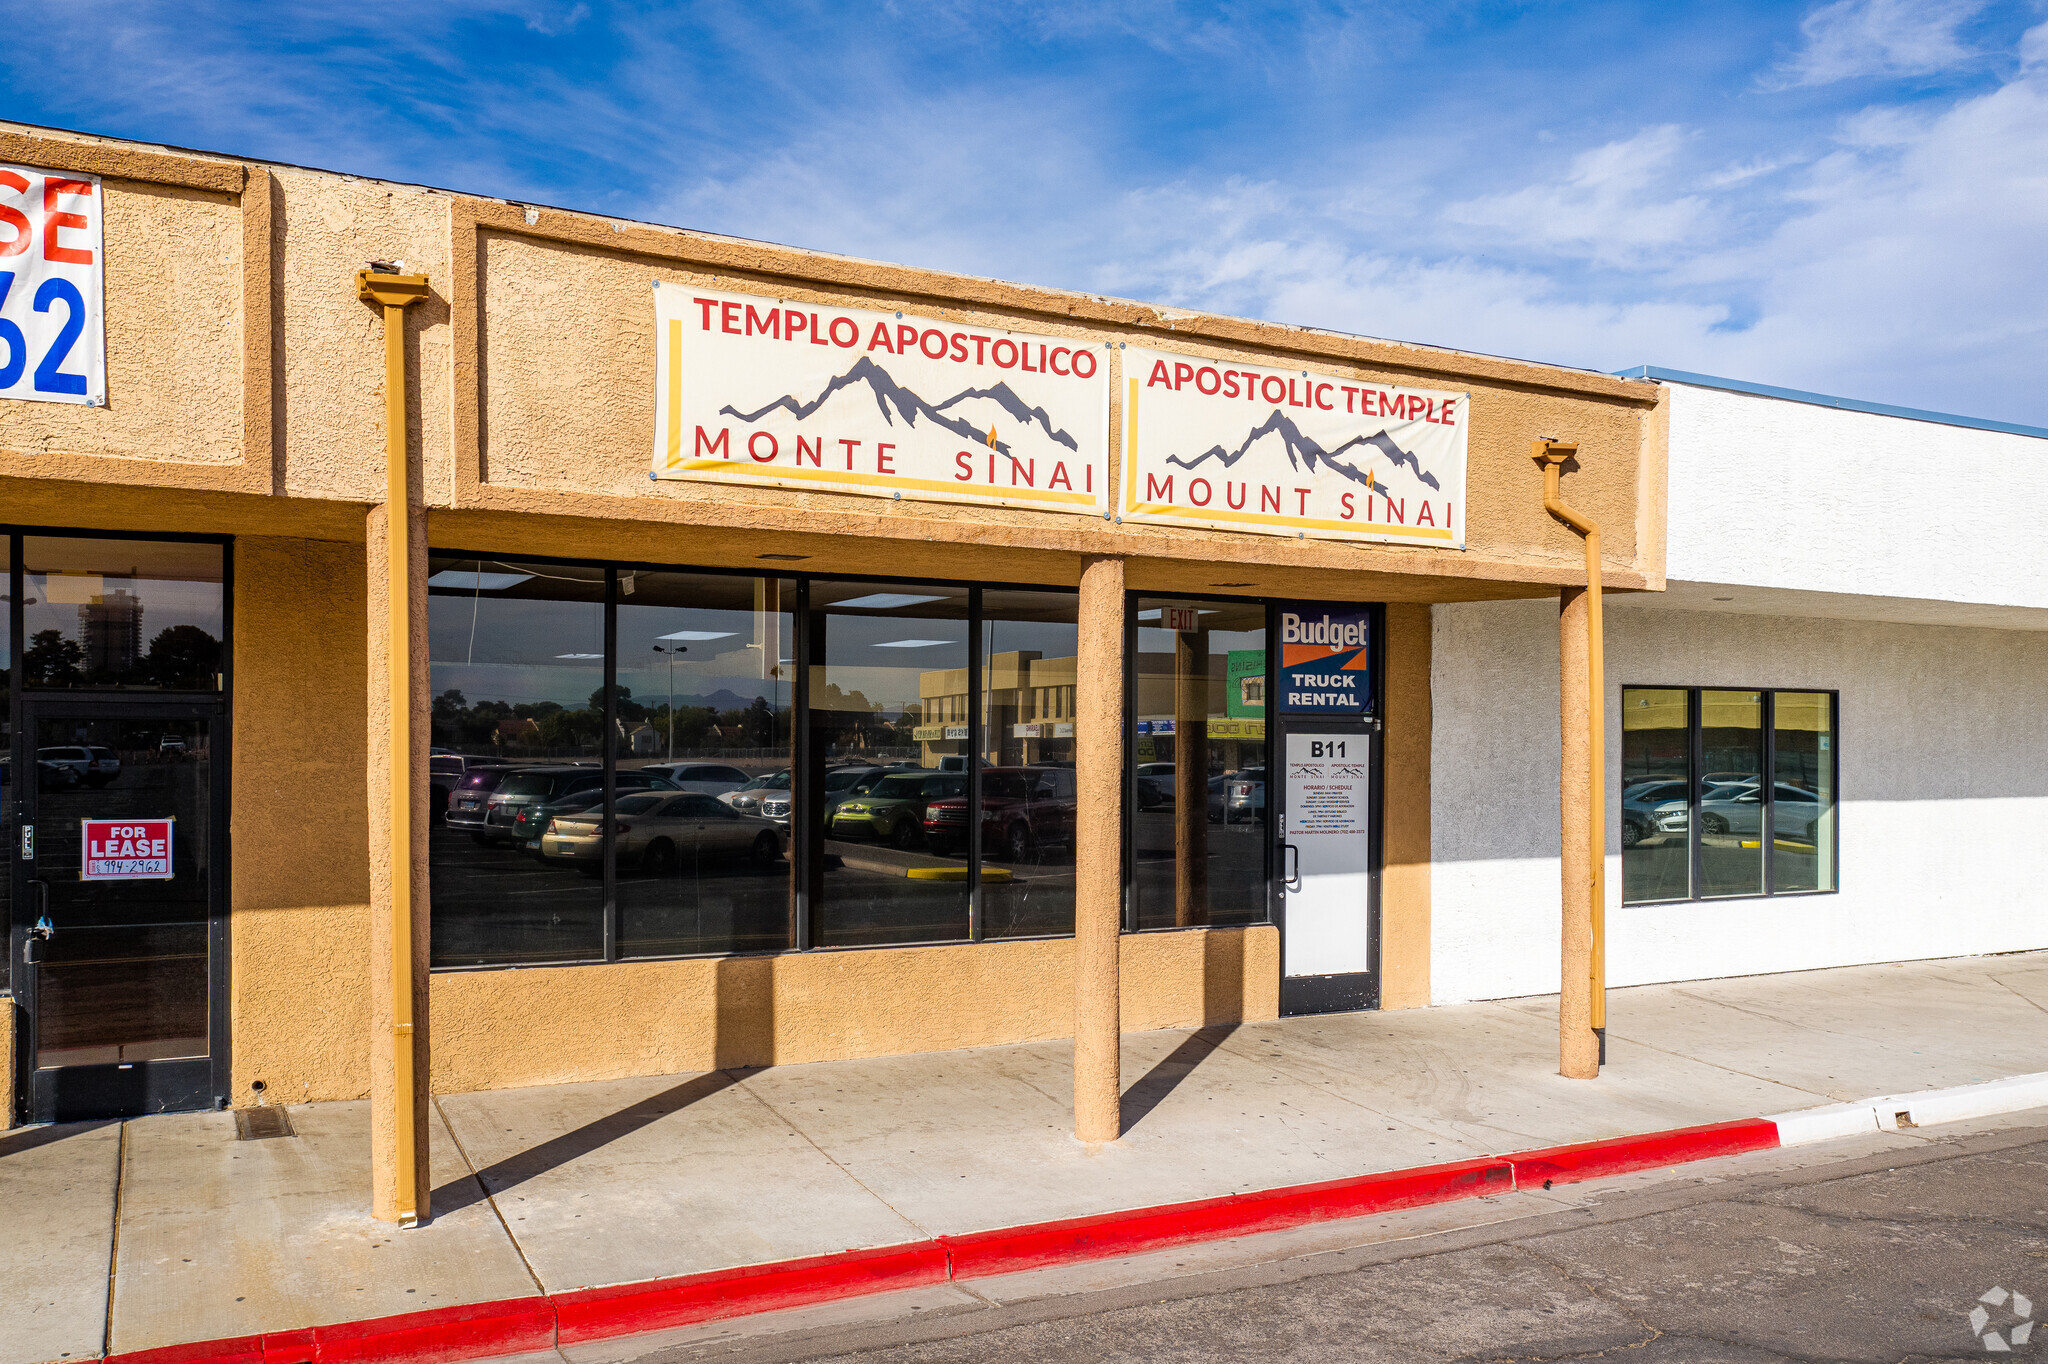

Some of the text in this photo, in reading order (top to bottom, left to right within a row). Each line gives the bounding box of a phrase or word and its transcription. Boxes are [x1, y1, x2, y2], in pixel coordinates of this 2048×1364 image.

[693, 297, 1097, 379] TEMPLO APOSTOLICO
[1147, 359, 1456, 426] APOSTOLIC TEMPLE
[694, 425, 1093, 493] MONTE SINAI
[1147, 472, 1452, 529] MOUNT SINAI
[1170, 608, 1194, 630] EXIT
[1282, 613, 1367, 652] Budget
[1291, 673, 1356, 688] TRUCK
[1288, 692, 1360, 706] RENTAL
[1311, 740, 1346, 758] B11
[111, 826, 146, 838] FOR
[90, 839, 166, 858] LEASE
[104, 860, 160, 873] 994-2962
